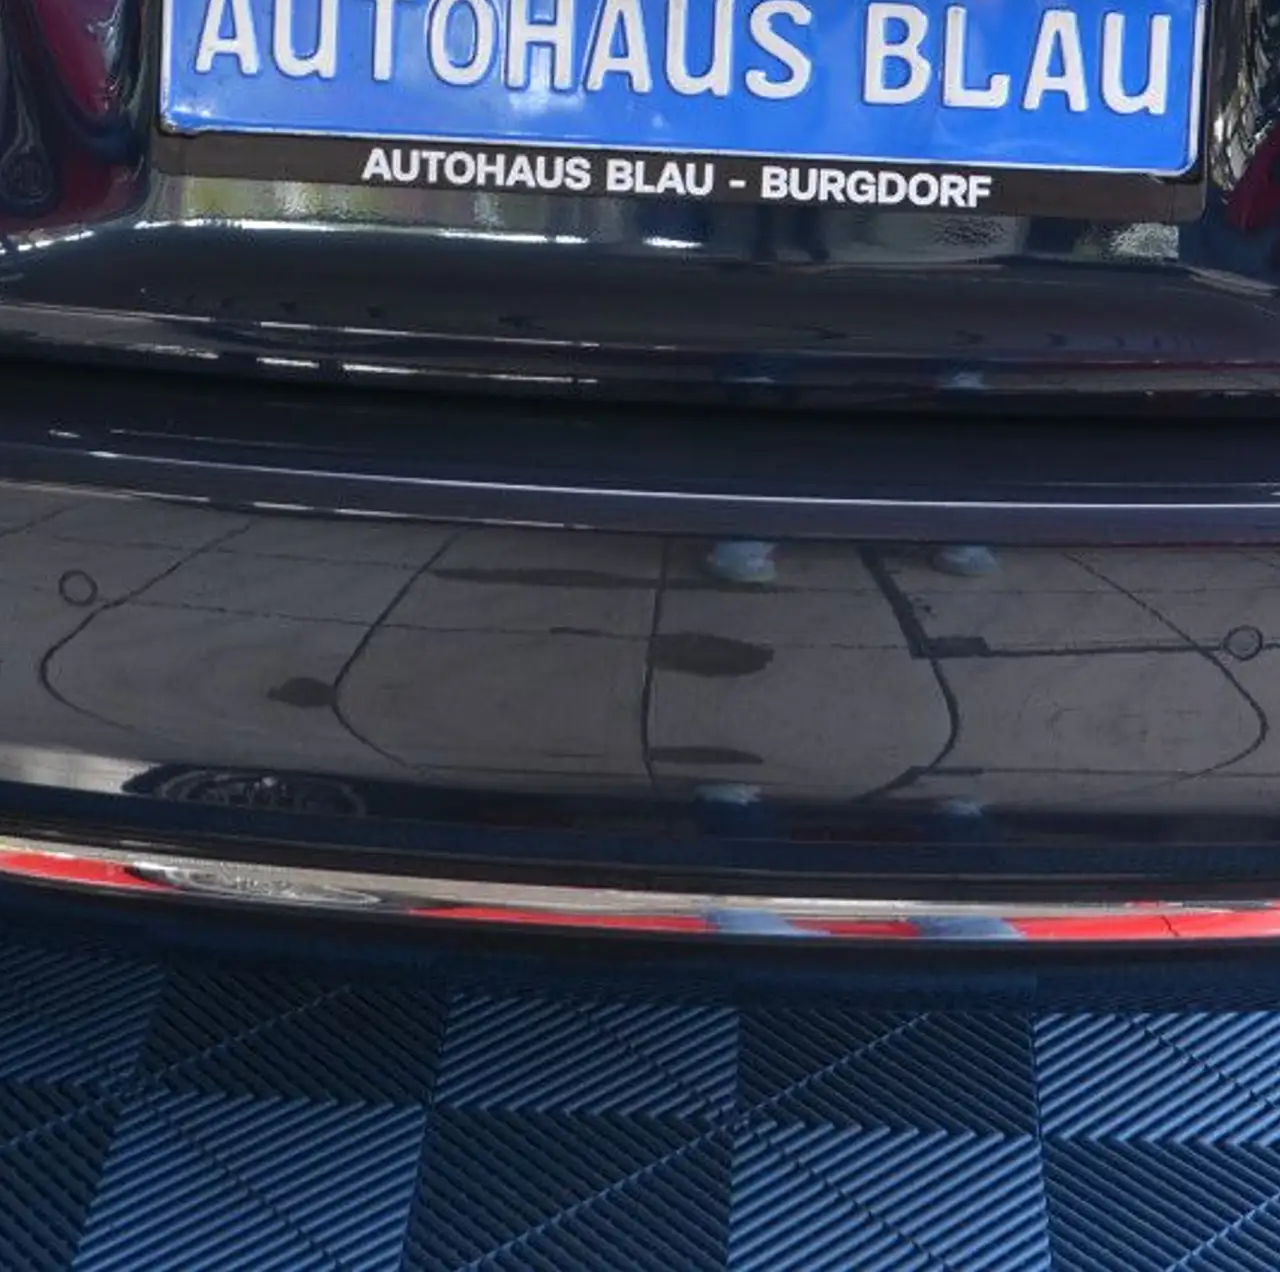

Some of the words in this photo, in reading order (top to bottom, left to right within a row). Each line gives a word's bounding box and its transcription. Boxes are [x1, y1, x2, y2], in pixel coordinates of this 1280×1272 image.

[863, 2, 1172, 115] BLAU
[362, 148, 591, 191] AUTOHAUS
[606, 159, 714, 197] BLAU
[761, 165, 992, 207] BURGDORF
